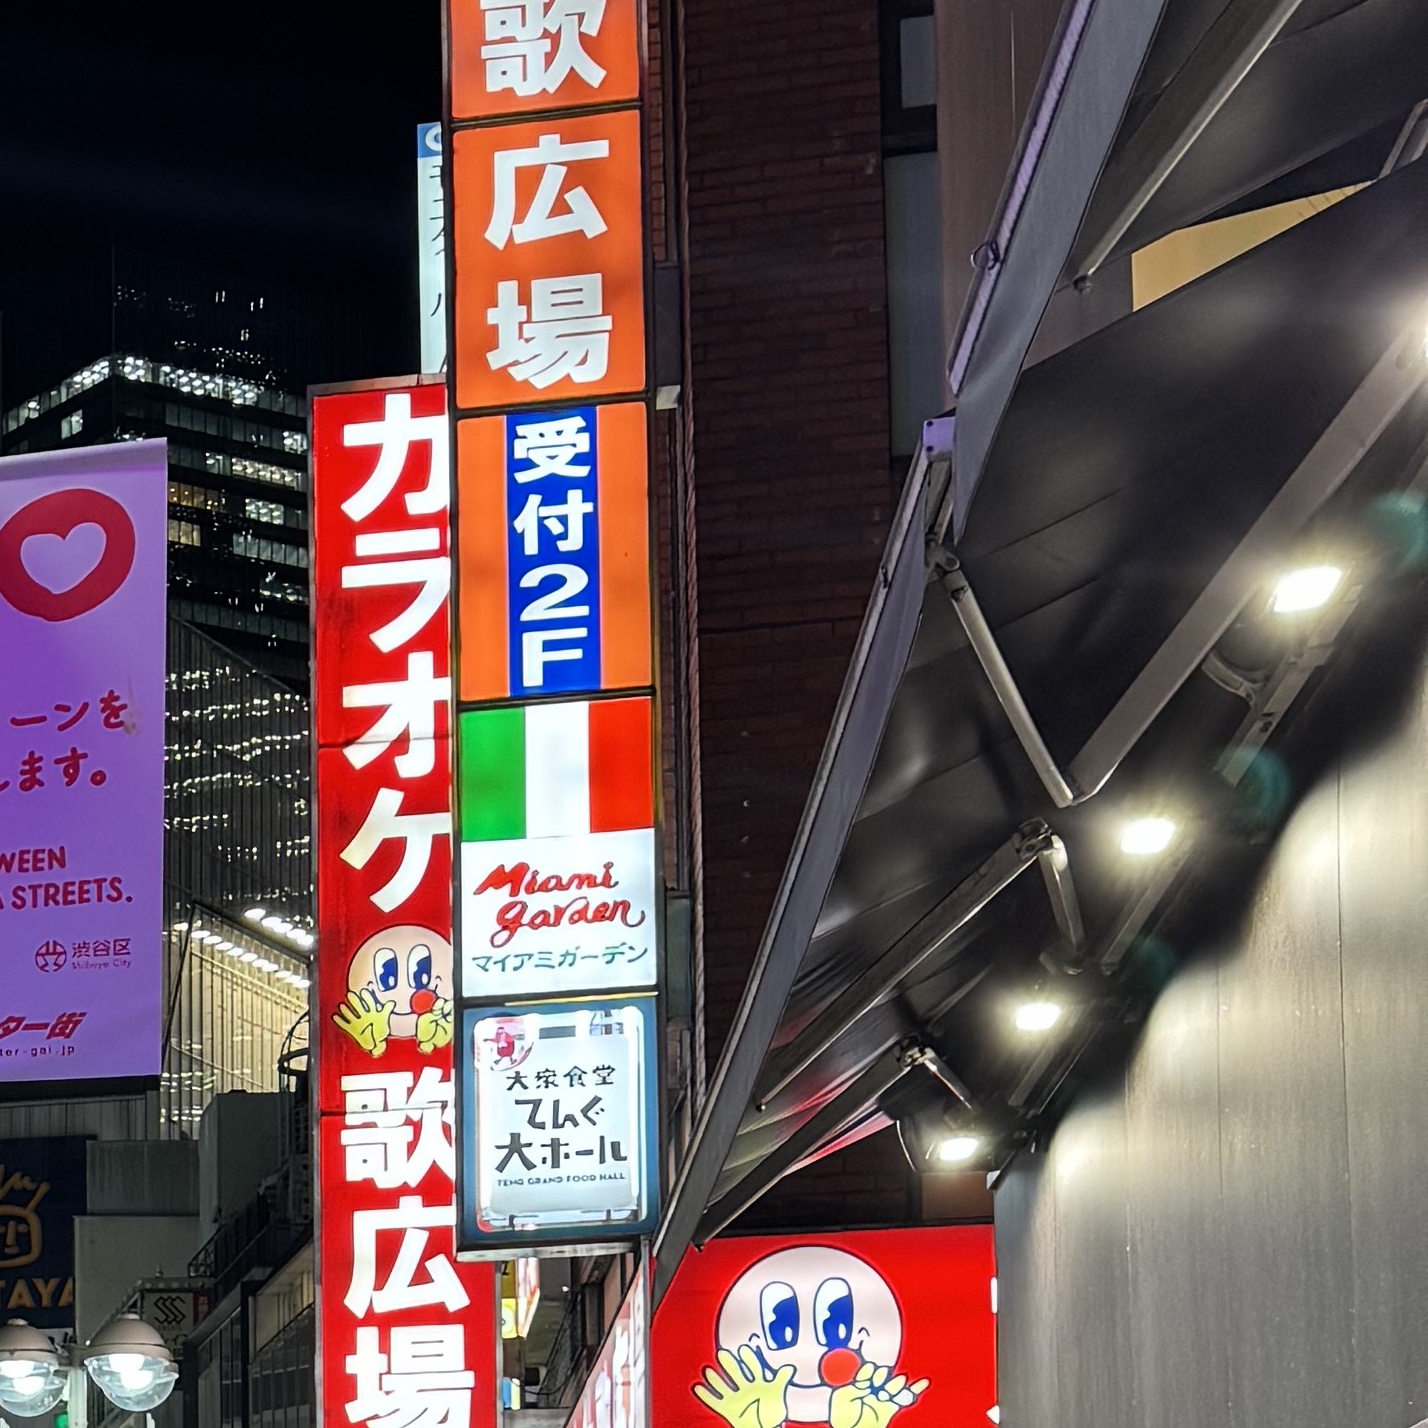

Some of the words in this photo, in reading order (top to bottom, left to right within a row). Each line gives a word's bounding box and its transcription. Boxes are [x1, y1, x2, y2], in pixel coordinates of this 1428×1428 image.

[481, 0, 612, 390] 歌広場
[513, 416, 594, 687] 受付2F
[339, 392, 452, 914] カラオケ
[11, 878, 134, 911] STREETS.
[473, 861, 620, 900] Miami
[72, 938, 131, 958] 渋谷区
[471, 942, 648, 974] マイアミガーデン
[514, 1095, 605, 1130] てんぐ
[495, 1132, 629, 1174] 大ホール
